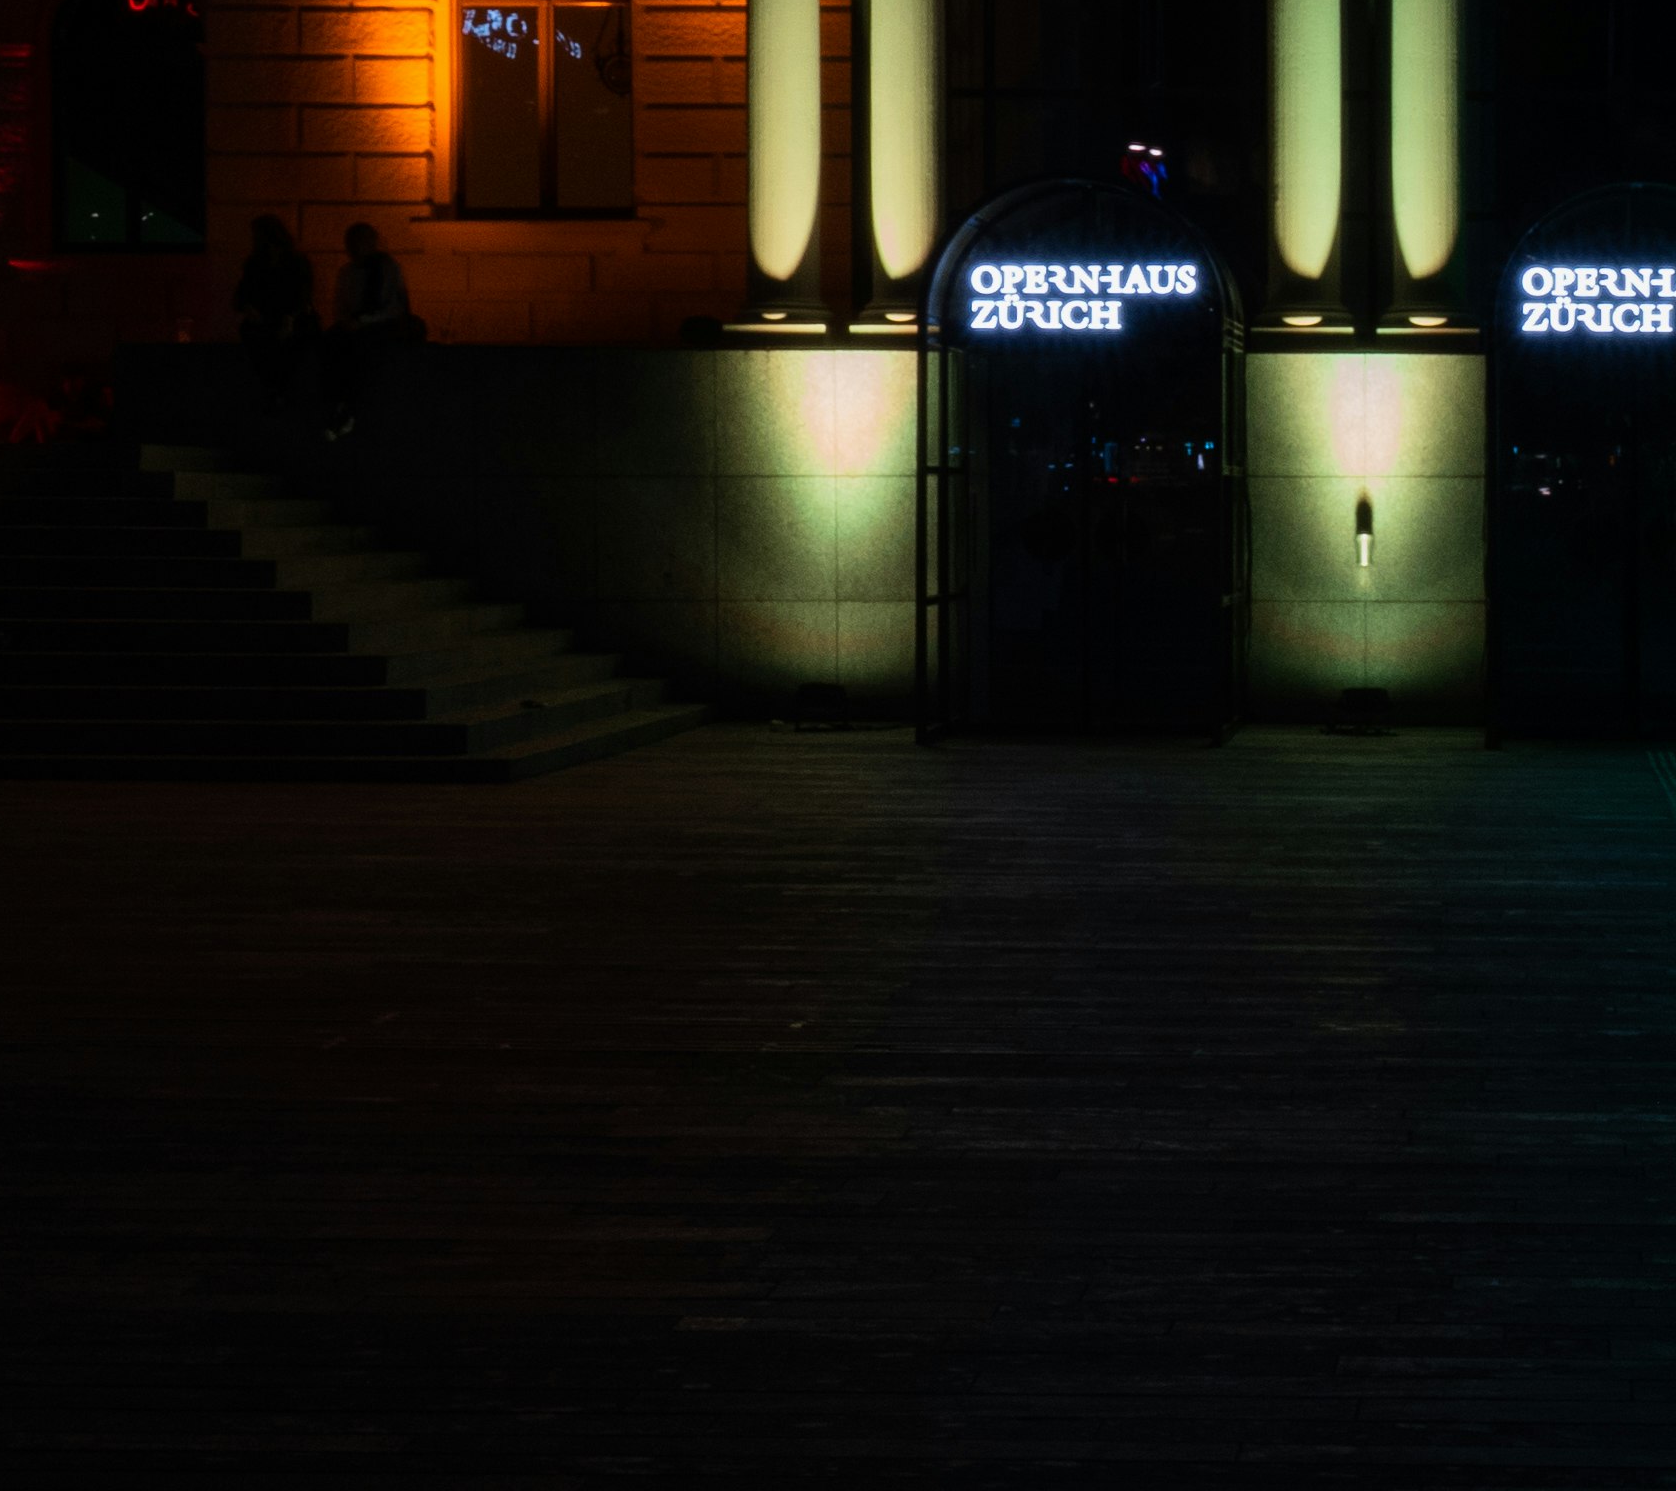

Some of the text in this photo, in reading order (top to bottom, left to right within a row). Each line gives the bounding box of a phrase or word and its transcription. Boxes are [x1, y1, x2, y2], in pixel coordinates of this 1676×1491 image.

[970, 263, 1197, 295] OPERNHAUS
[970, 294, 1123, 330] ZÜRICH
[1521, 296, 1674, 333] ZÜRICH
